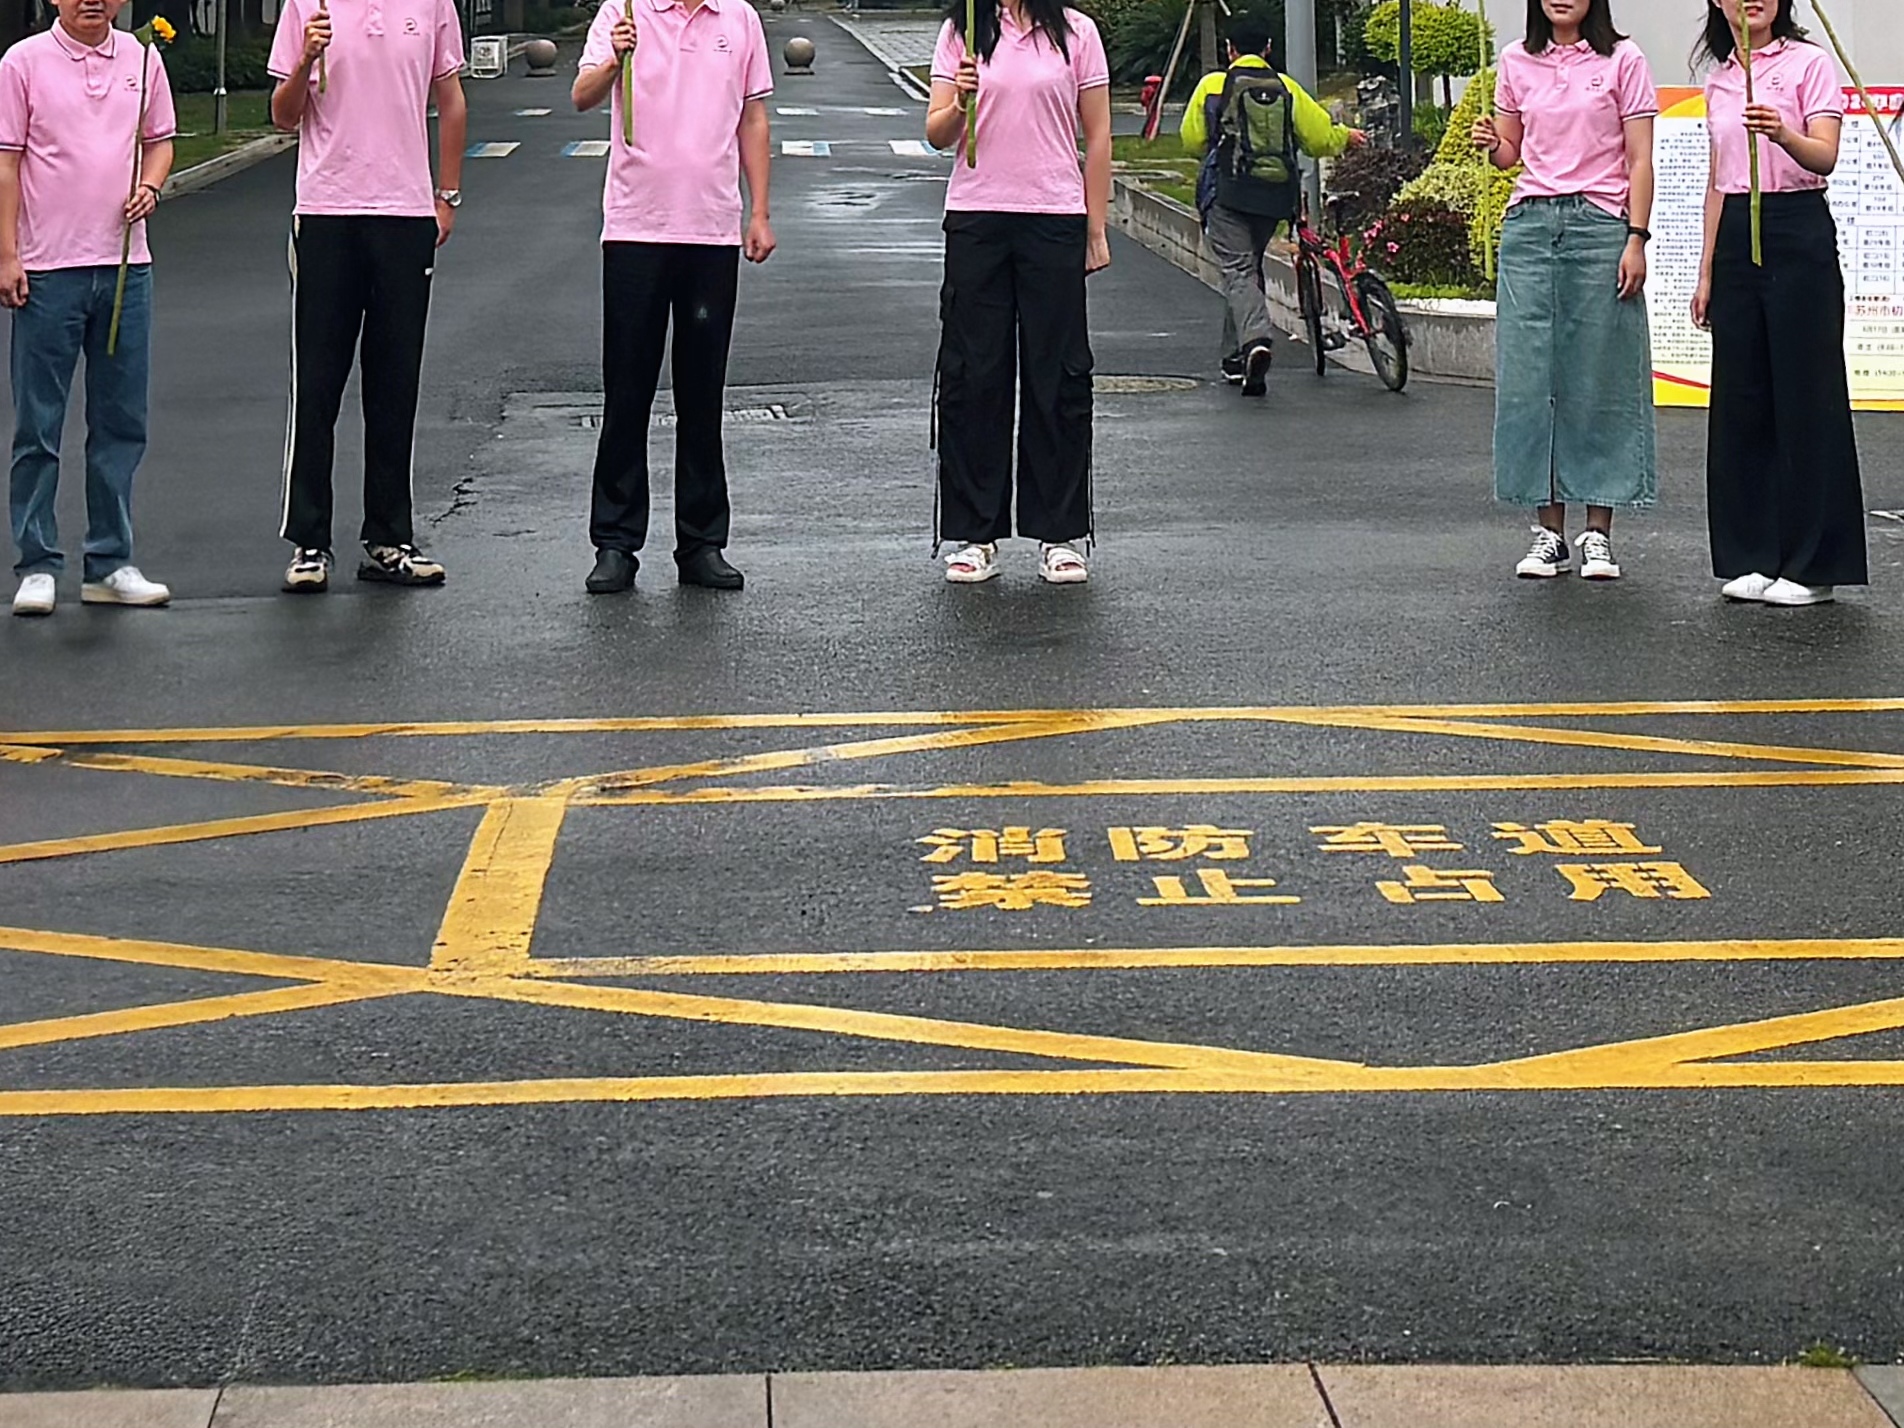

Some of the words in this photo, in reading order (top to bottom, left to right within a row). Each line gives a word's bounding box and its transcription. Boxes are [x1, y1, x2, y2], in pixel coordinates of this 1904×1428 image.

[916, 819, 1664, 864] 消防车道
[929, 861, 1712, 911] 禁止占用
